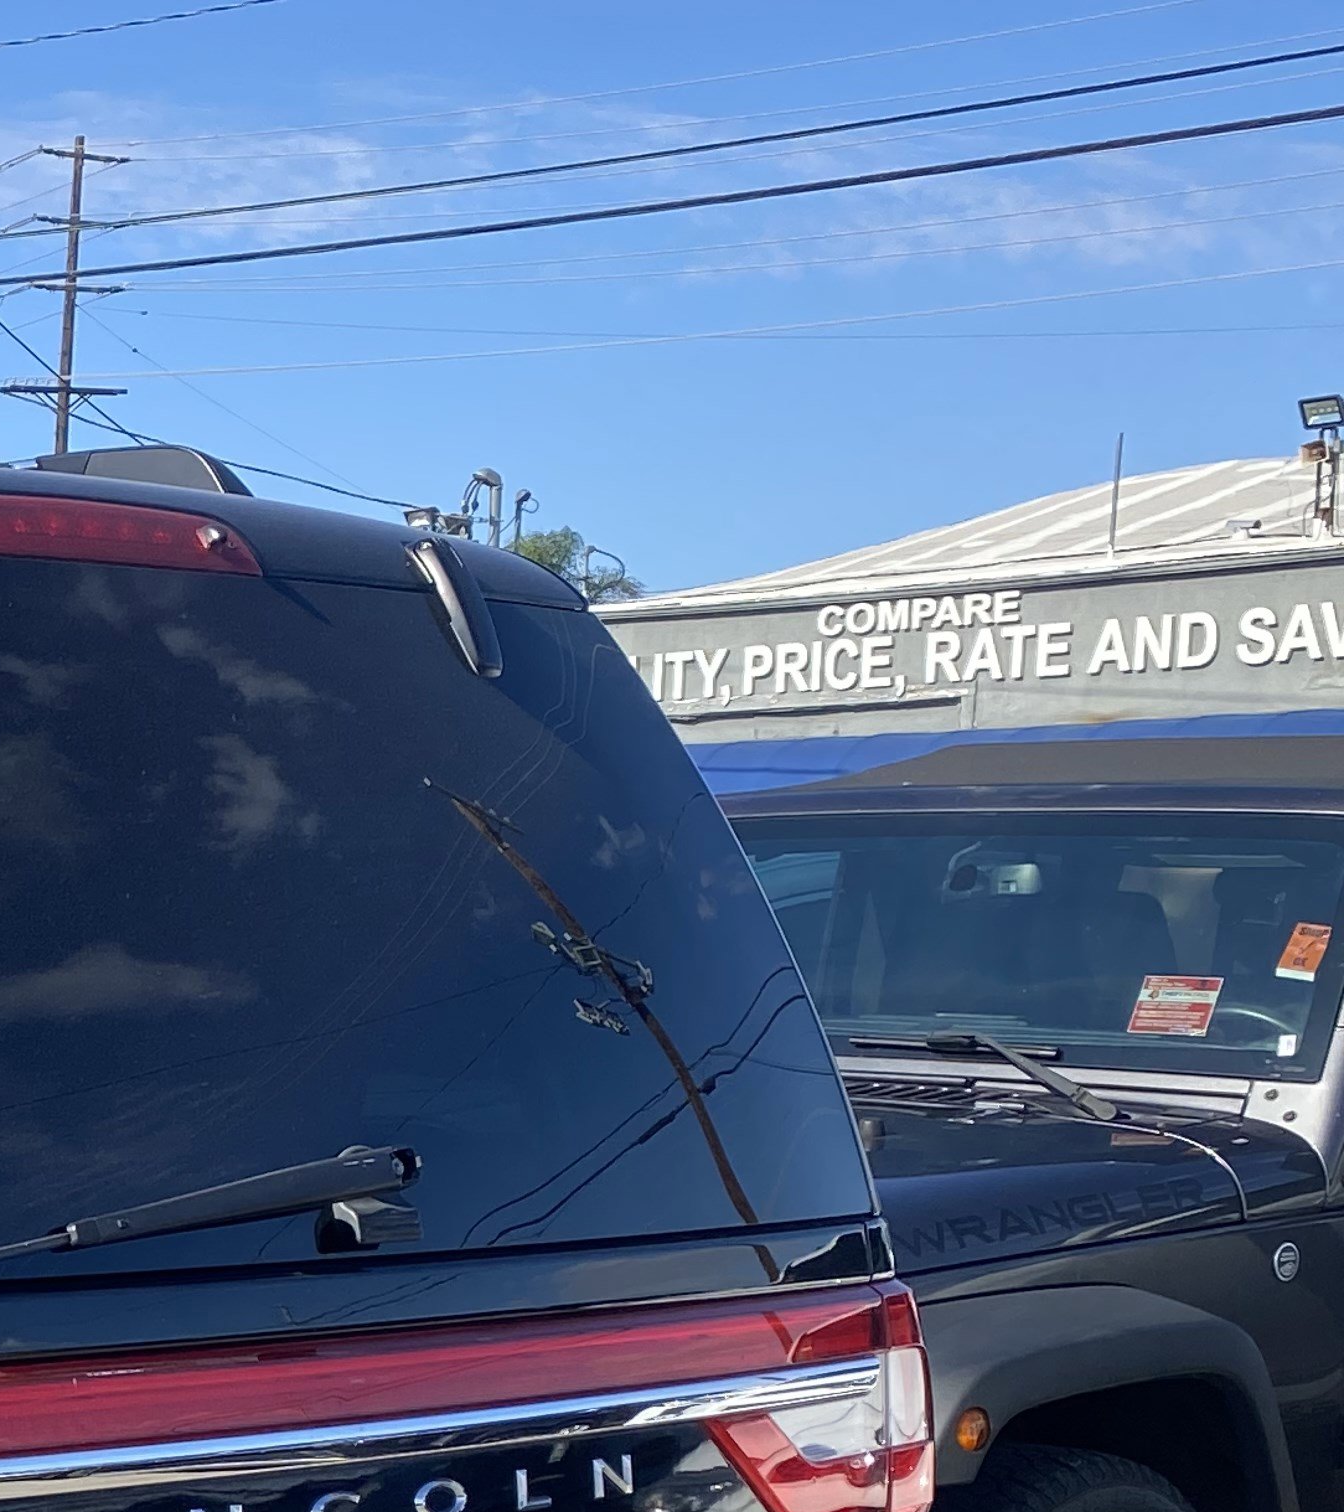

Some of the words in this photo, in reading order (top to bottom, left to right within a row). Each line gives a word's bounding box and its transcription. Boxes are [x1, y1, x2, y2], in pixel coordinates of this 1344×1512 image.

[628, 648, 731, 707] ITY,
[742, 635, 908, 699] PRICE,
[924, 622, 1072, 685] RATE
[1087, 611, 1217, 676] AND
[1235, 601, 1344, 667] SAV
[817, 590, 1021, 637] COMPARE
[892, 1177, 1205, 1258] WRANGLER
